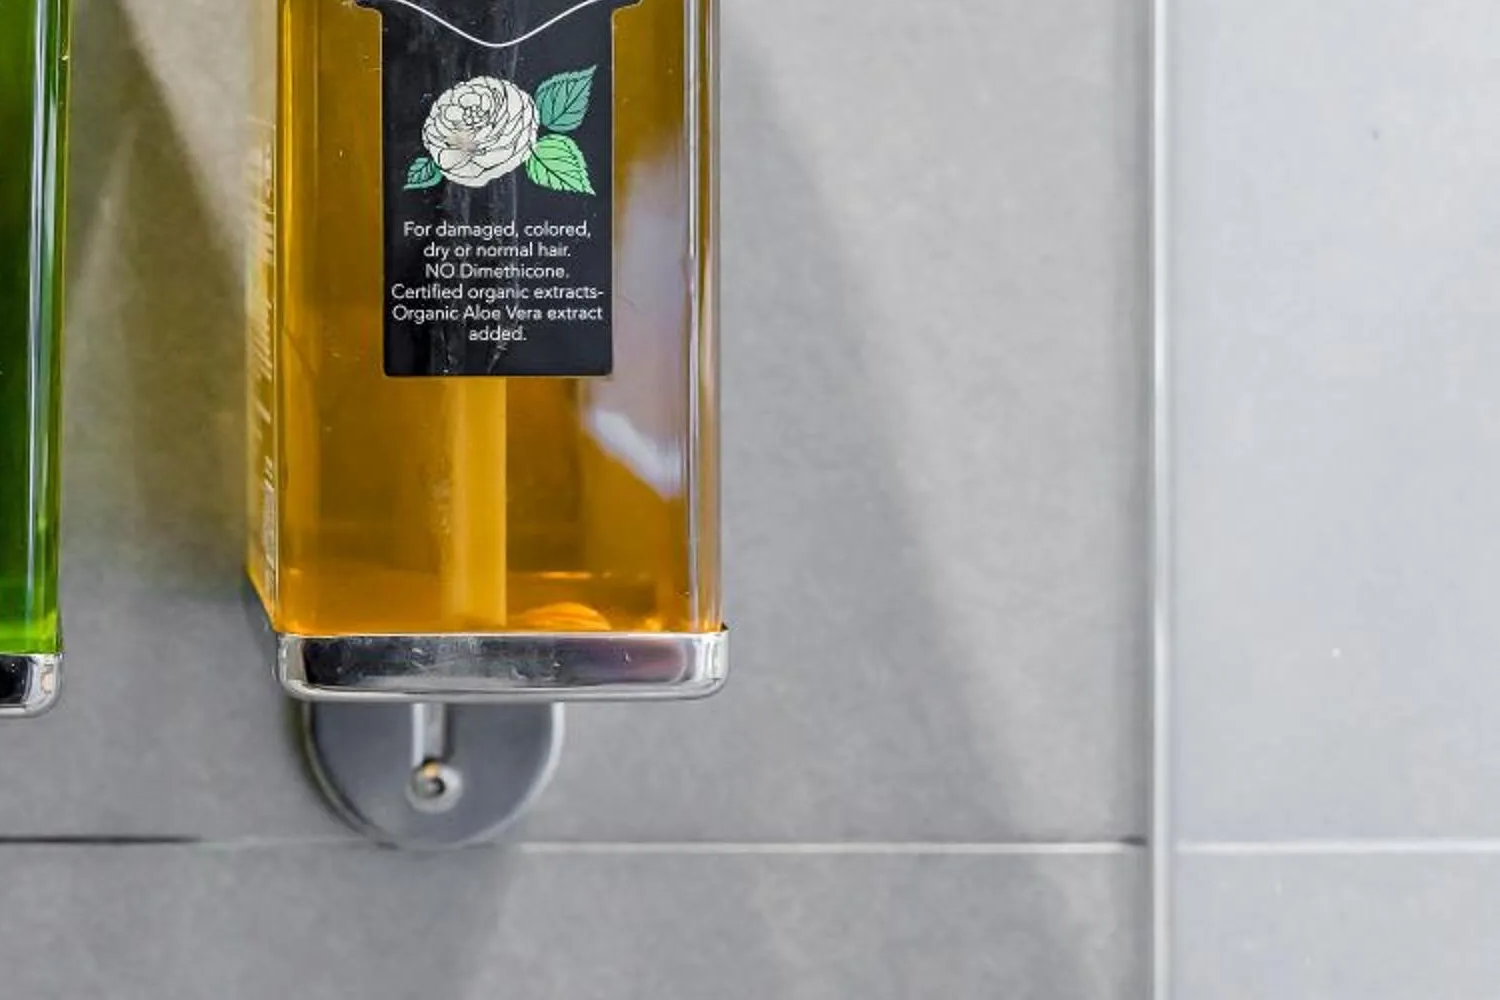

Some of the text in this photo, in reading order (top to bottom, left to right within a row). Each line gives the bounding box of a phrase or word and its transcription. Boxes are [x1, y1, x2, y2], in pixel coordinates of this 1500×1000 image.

[403, 221, 591, 242] For damaged, colored,
[423, 242, 571, 261] dry or normal hair.
[425, 263, 570, 279] NO Dimethicone.
[391, 284, 604, 304] Certified organic extracts-
[392, 305, 603, 325] Organic Aloe Vera extract
[468, 326, 528, 342] added.
